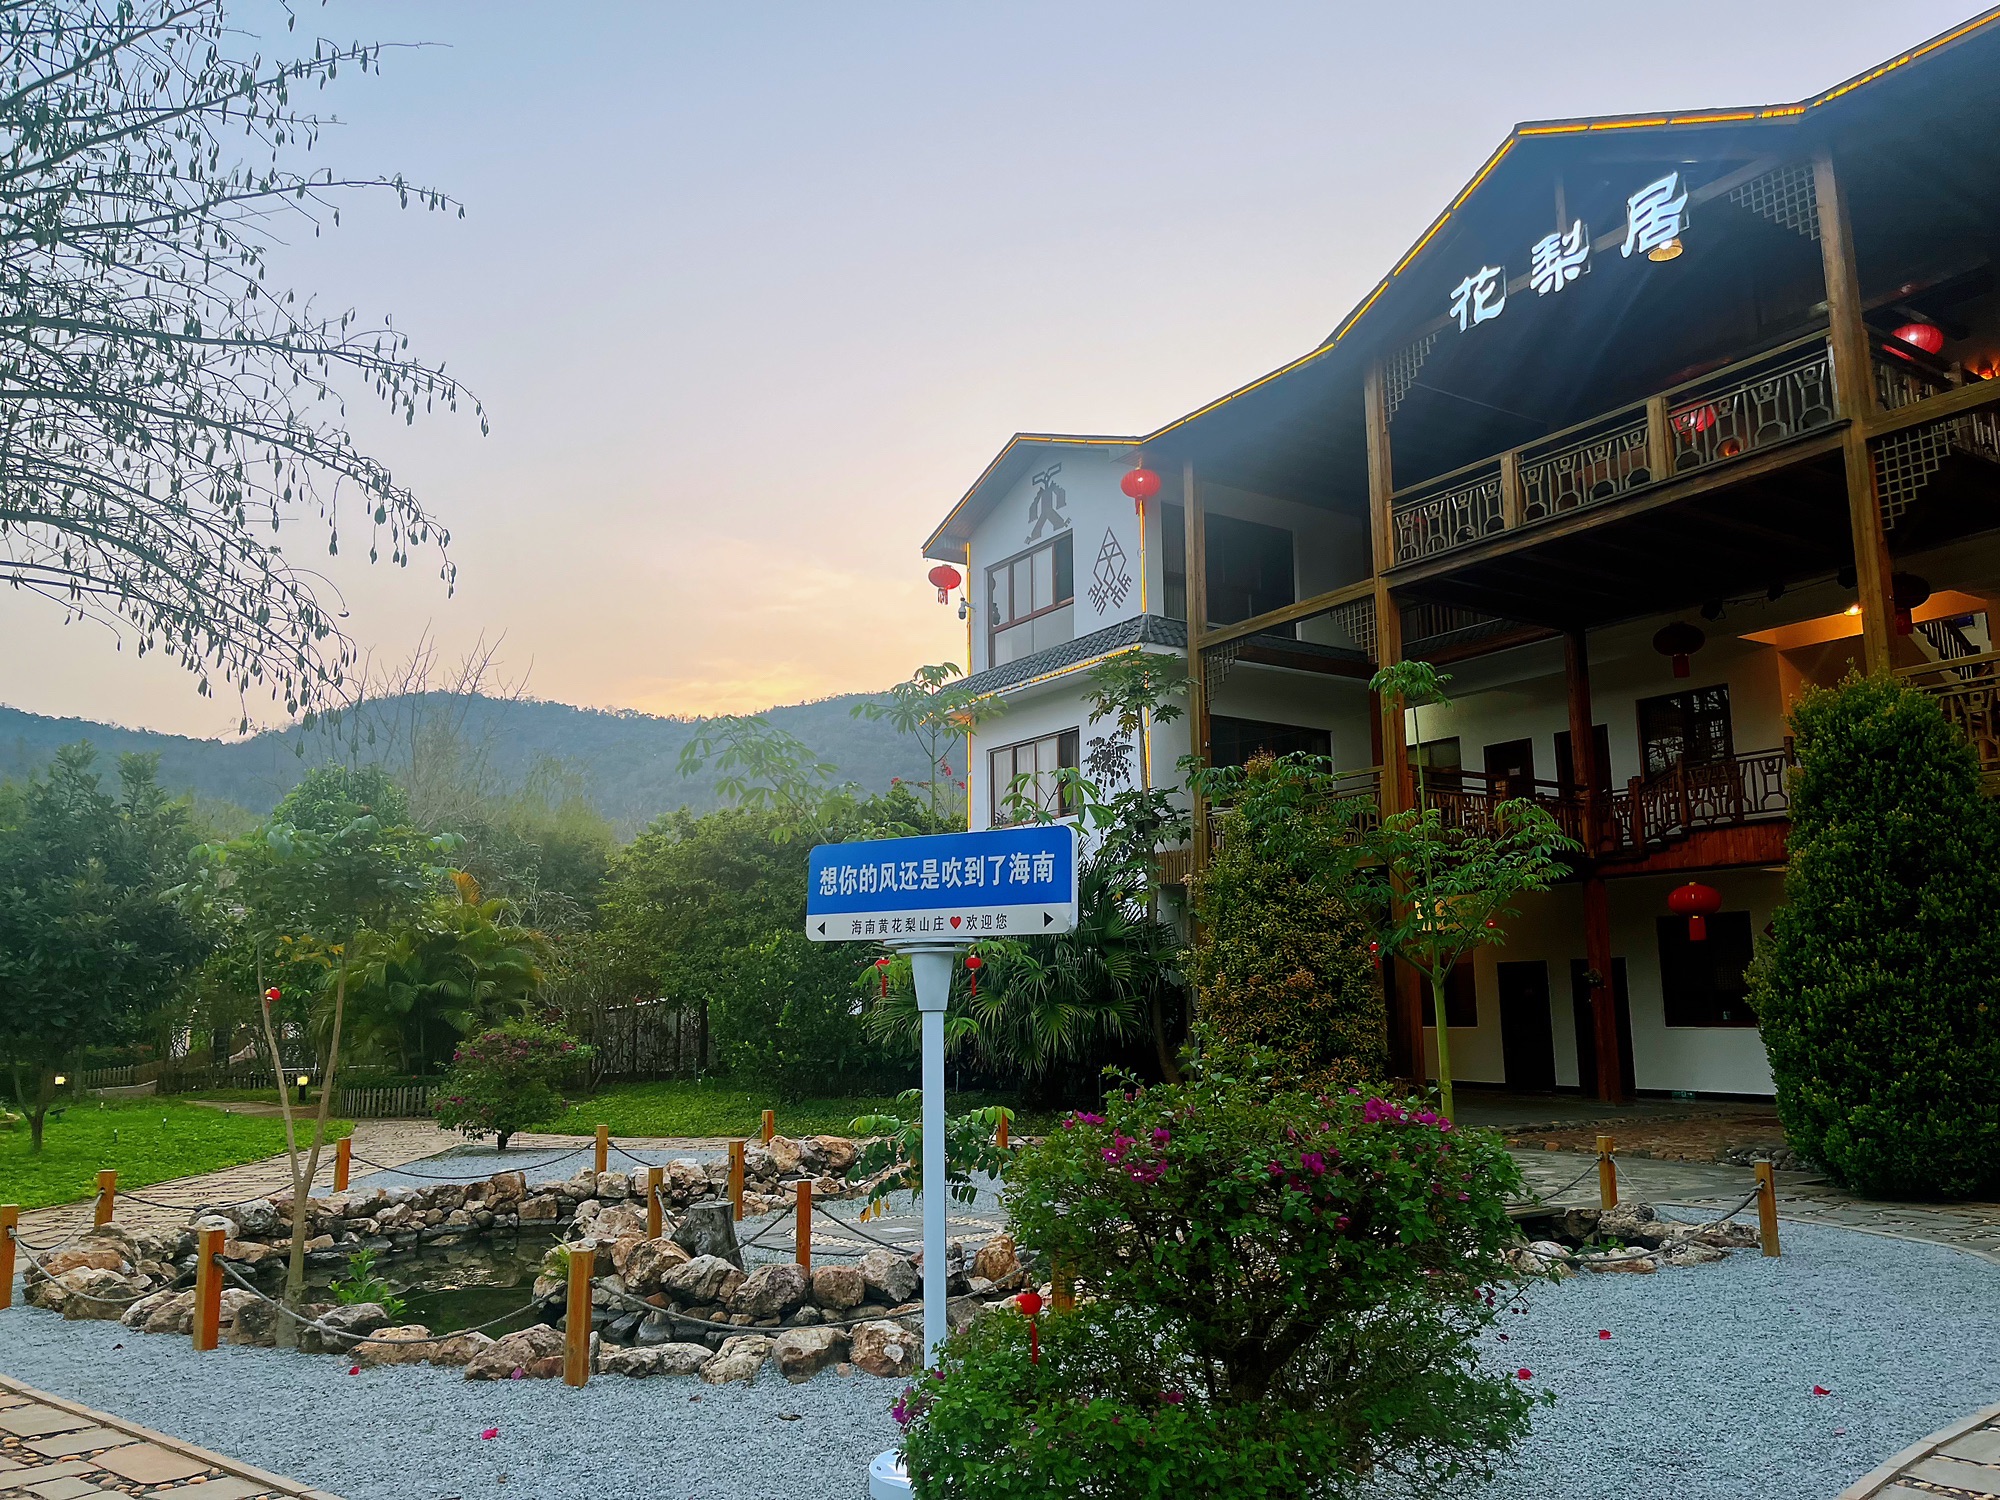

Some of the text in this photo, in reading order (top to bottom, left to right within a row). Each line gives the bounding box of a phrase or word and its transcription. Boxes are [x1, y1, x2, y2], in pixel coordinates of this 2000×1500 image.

[1450, 172, 1688, 332] 花梨居
[819, 850, 1055, 896] 想你的风还是吹到了海南
[851, 913, 1008, 935] 海南黄花梨山庄 欢迎您
